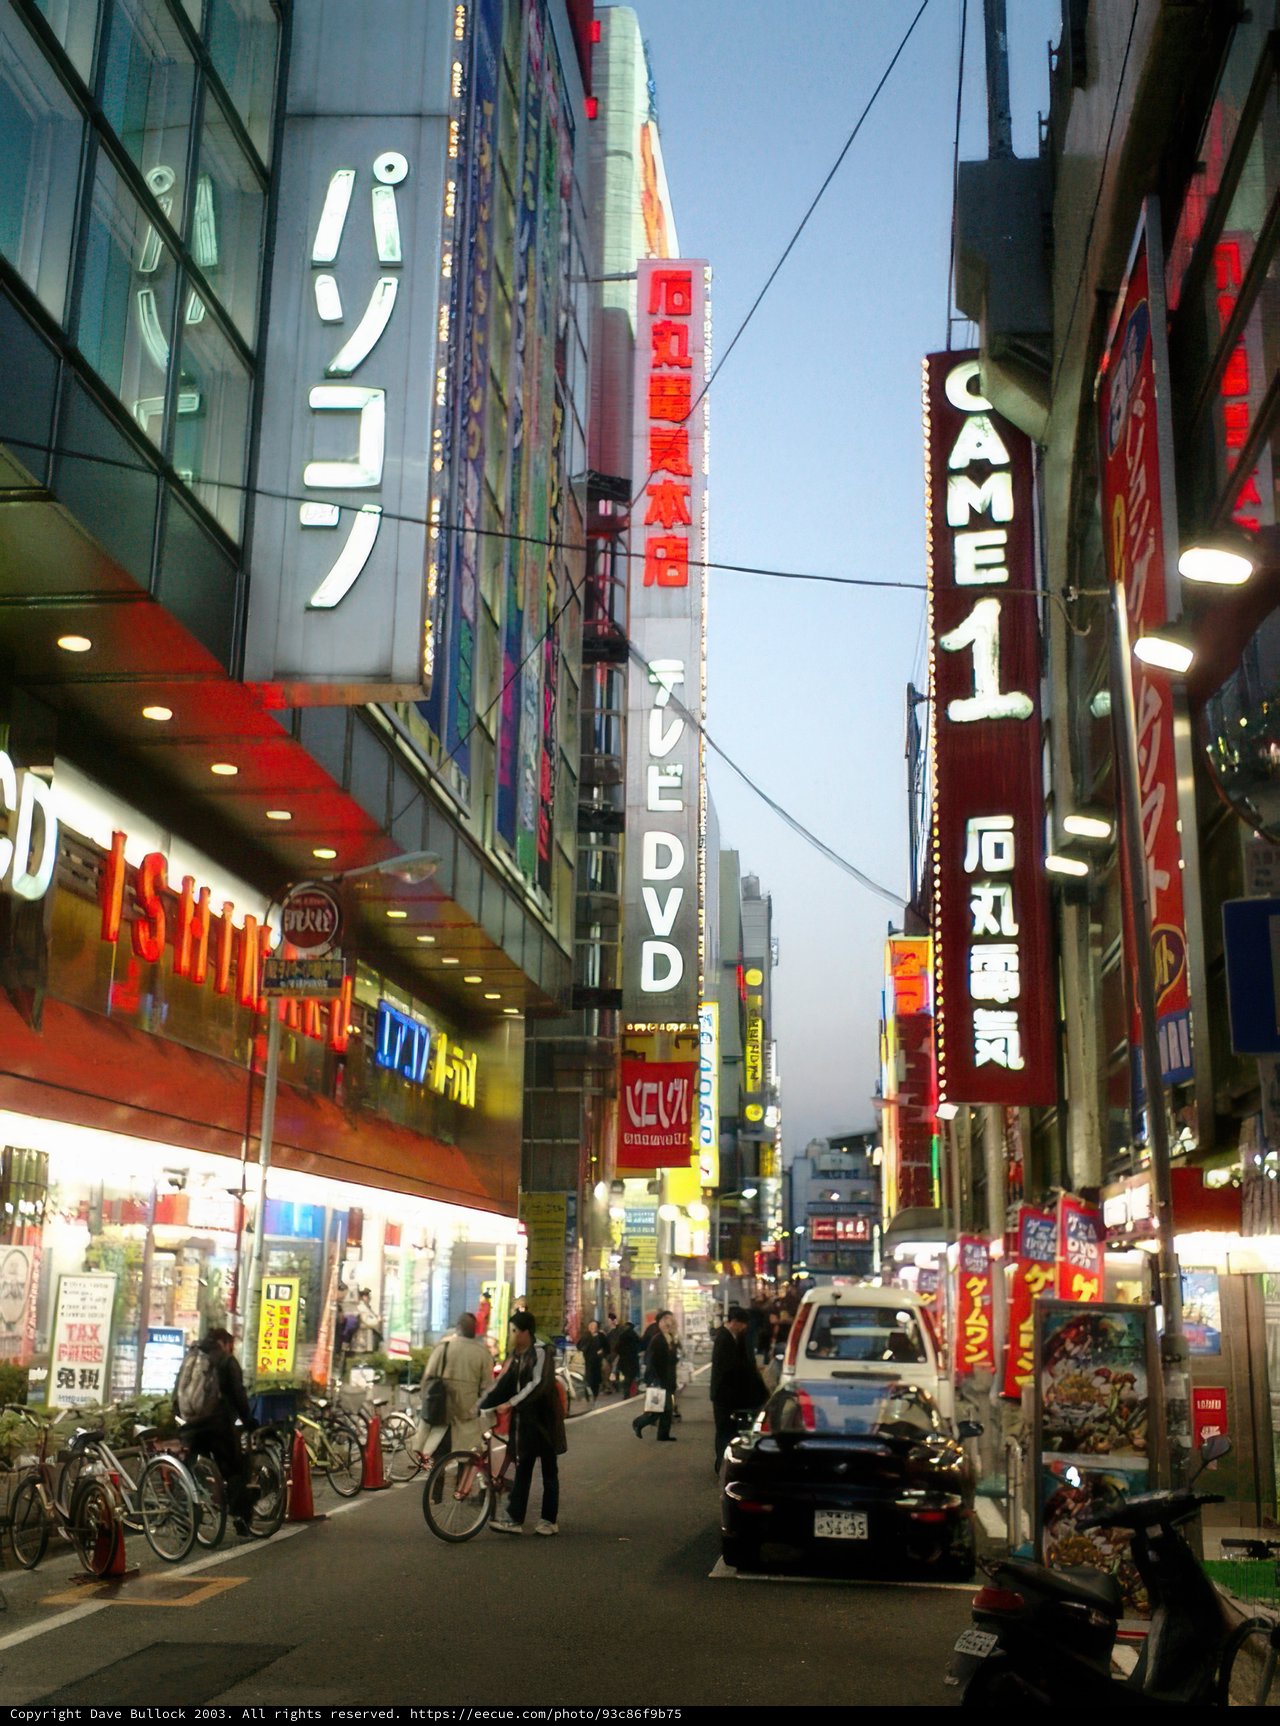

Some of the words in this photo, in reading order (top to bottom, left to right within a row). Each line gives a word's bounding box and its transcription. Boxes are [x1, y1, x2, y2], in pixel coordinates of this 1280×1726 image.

[299, 151, 409, 608] パソコン
[643, 269, 693, 588] 石丸電気本店
[645, 658, 686, 813] テレビ
[640, 829, 686, 993] DVD
[964, 814, 1025, 1071] 石丸電気
[65, 1322, 101, 1343] TAX
[964, 1275, 989, 1364] ゲームワン
